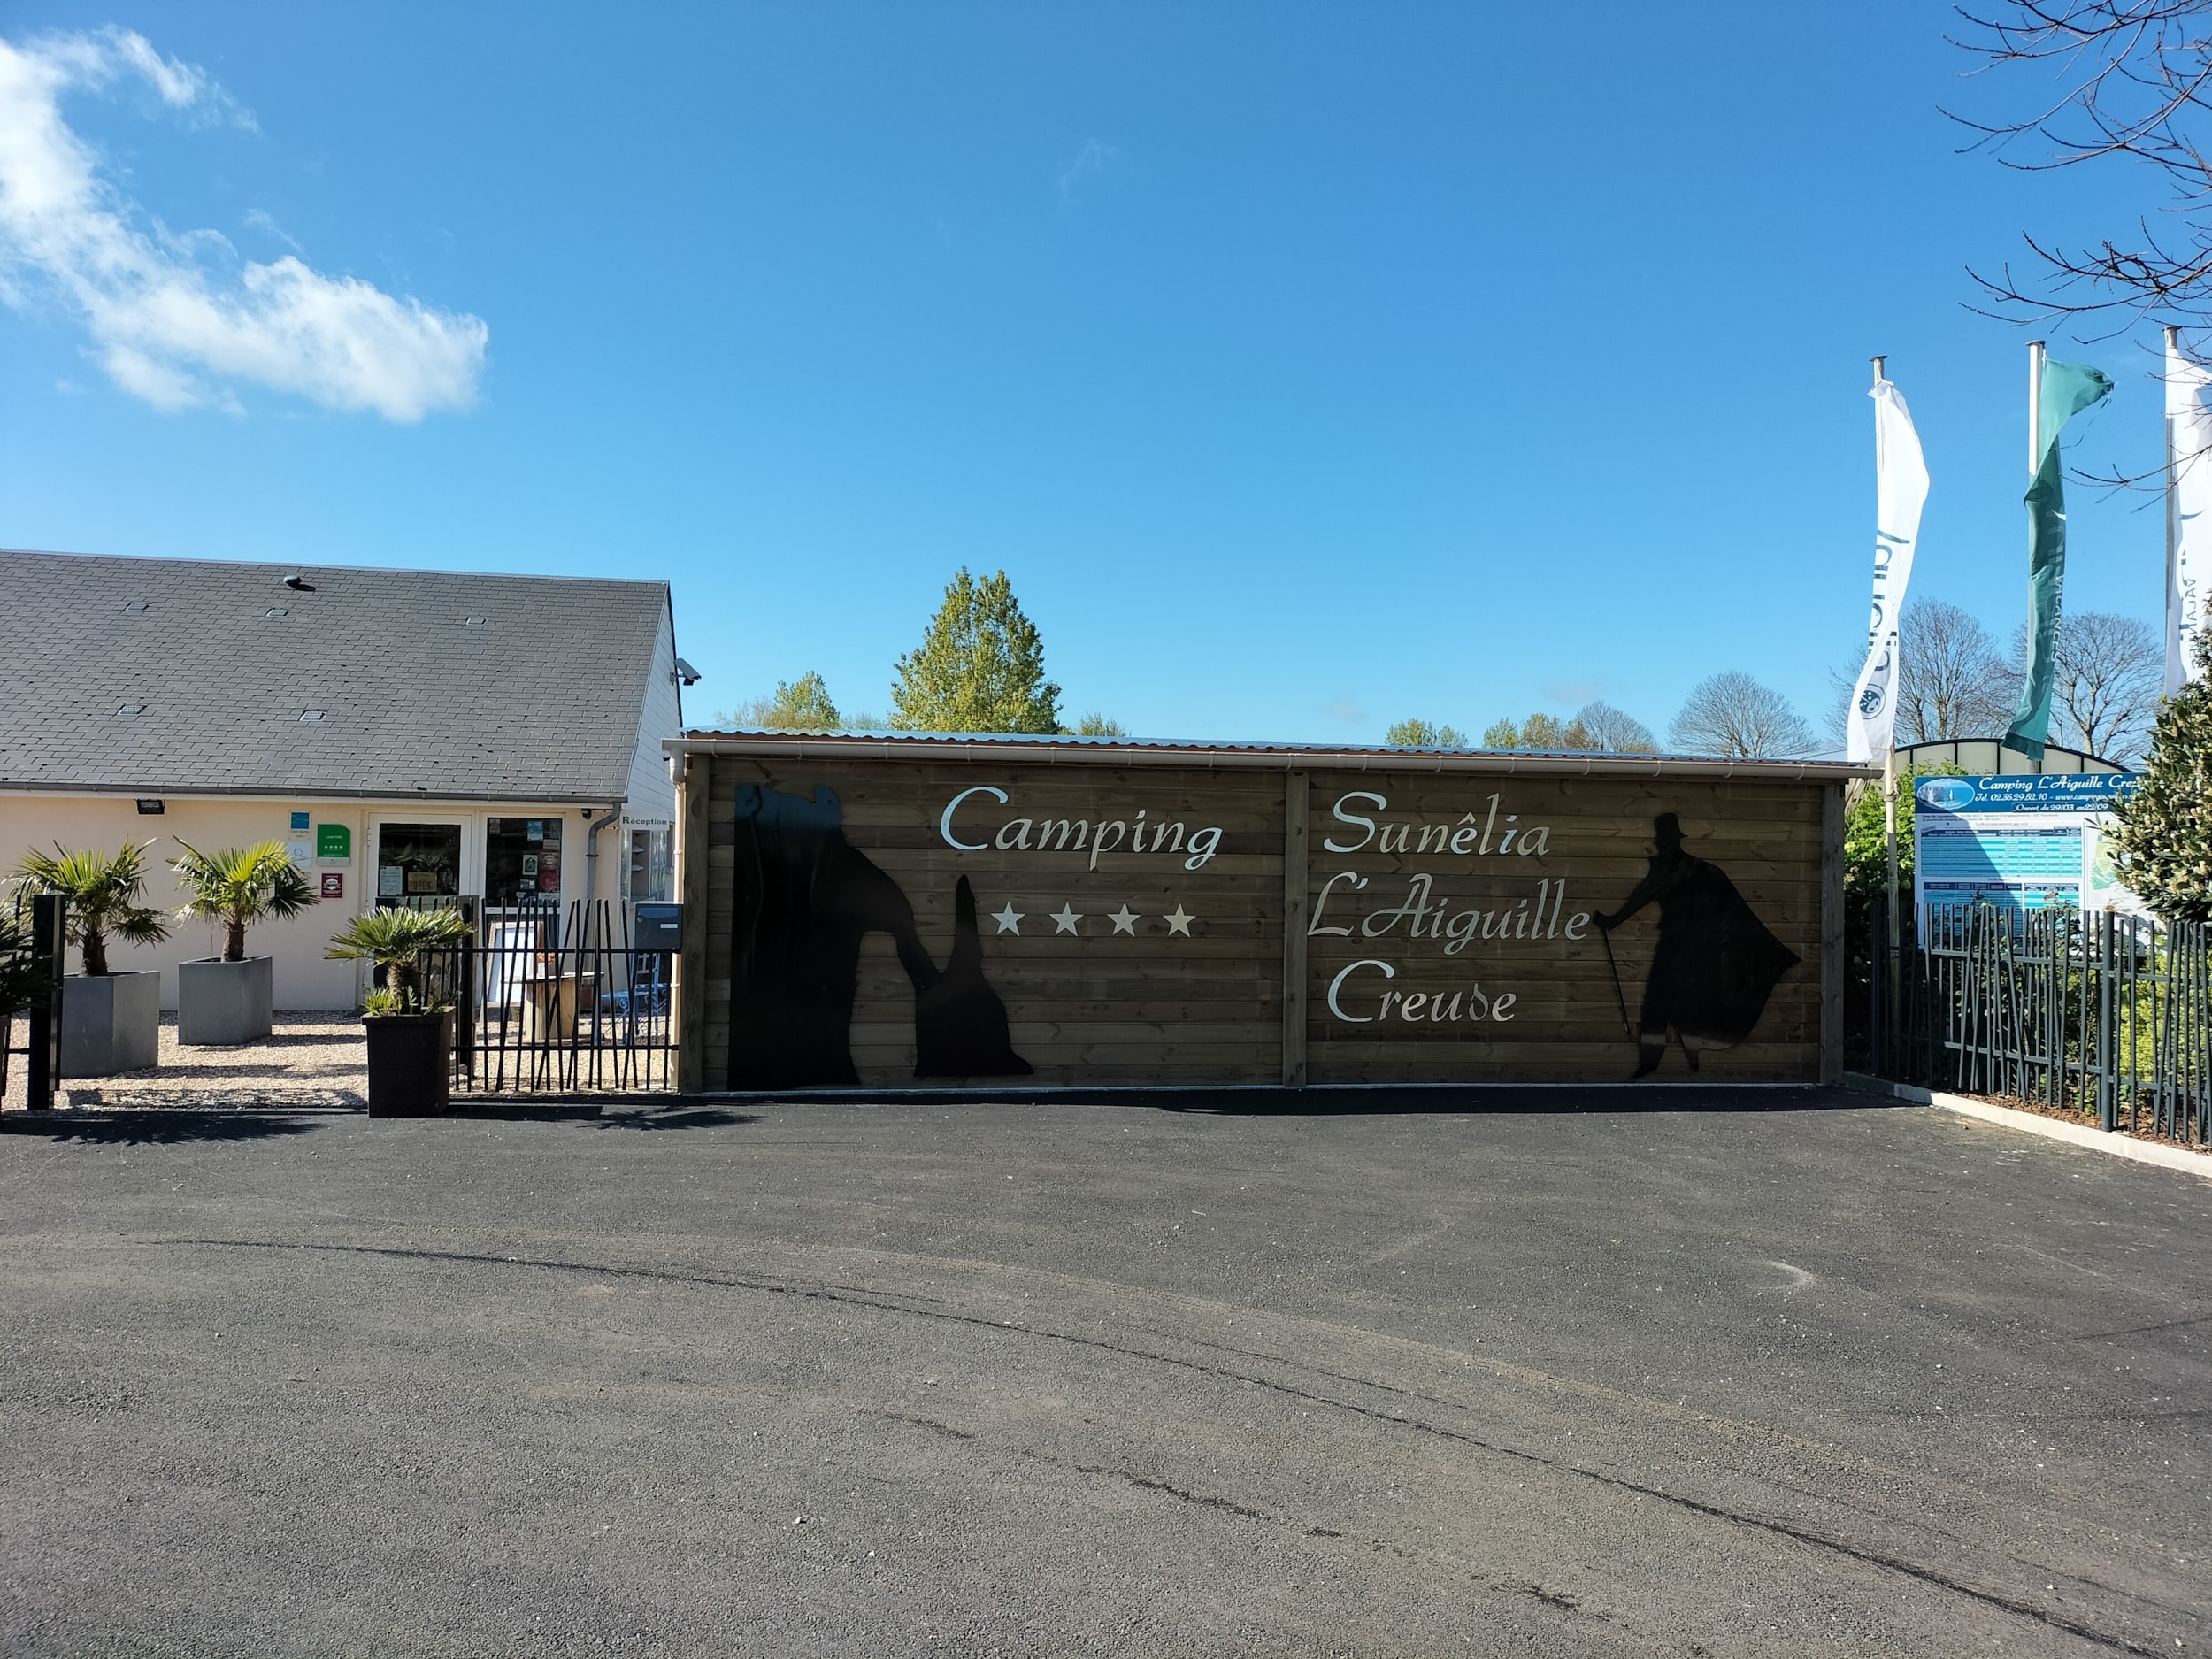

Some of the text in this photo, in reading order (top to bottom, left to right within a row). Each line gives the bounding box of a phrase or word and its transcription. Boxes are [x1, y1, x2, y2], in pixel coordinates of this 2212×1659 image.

[2050, 575, 2064, 662] VACANCES
[1978, 777, 2033, 792] Camping
[2037, 775, 2104, 792] L'Aiguille
[622, 816, 667, 826] Réception
[940, 786, 1223, 871] Camping
[1324, 791, 1550, 856] Sunêlia
[1307, 871, 1591, 956] L'Aiguille
[1328, 959, 1517, 1023] Creuse
